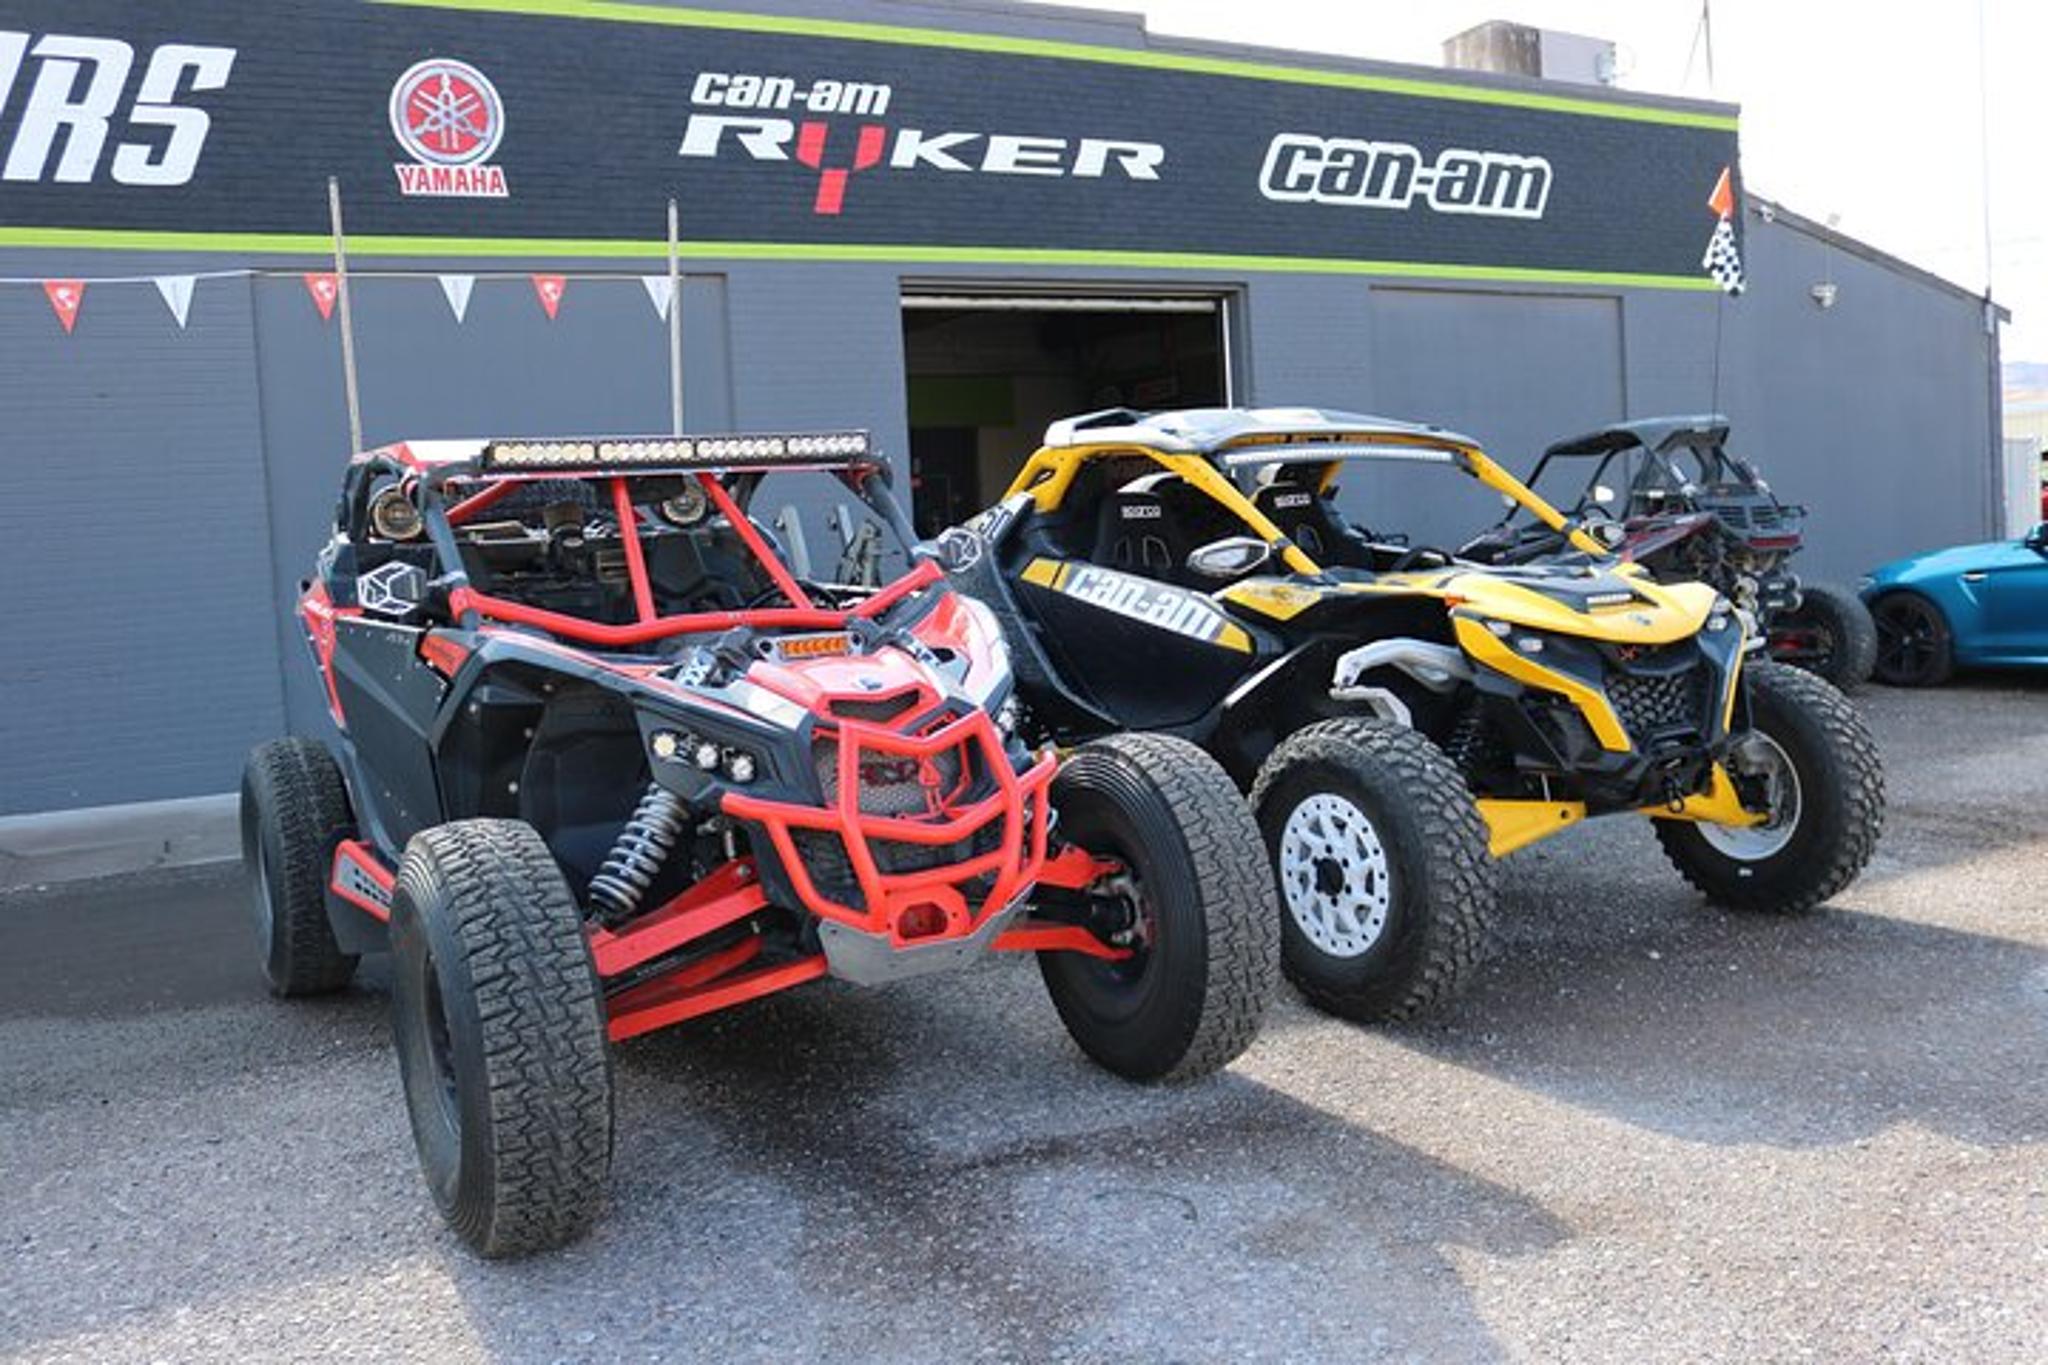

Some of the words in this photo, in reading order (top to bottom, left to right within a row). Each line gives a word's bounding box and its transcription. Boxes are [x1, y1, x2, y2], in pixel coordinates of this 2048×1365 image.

[0, 31, 237, 186] RS
[690, 72, 892, 115] can-am
[397, 165, 507, 196] YAMAHA
[679, 114, 1165, 214] RYKER
[1260, 134, 1552, 219] can-am
[1065, 567, 1224, 642] can-am
